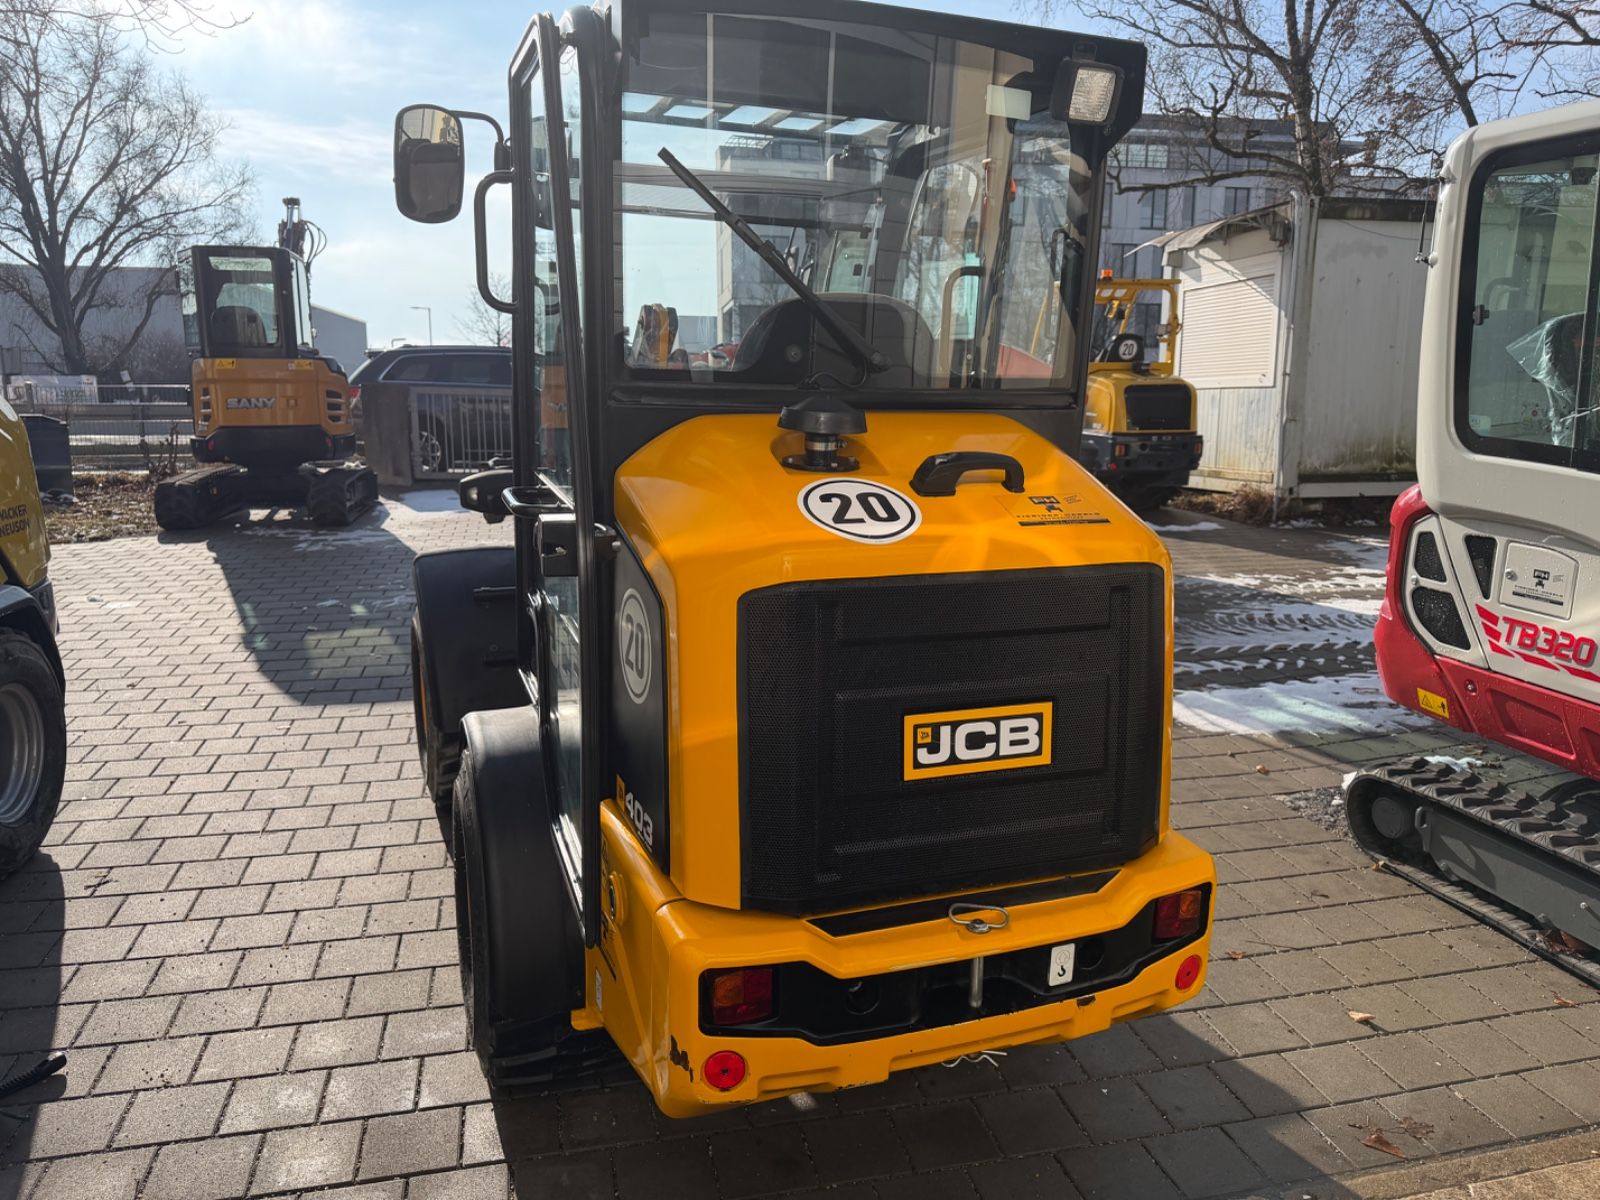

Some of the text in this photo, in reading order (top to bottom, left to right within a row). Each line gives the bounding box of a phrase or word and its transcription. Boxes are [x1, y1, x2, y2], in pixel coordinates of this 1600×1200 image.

[1122, 343, 1135, 356] 20
[226, 398, 275, 410] SANY
[819, 492, 901, 524] 20
[625, 613, 645, 680] 20
[1502, 616, 1598, 667] TB320
[917, 717, 1040, 765] JCB
[625, 792, 653, 847] 403
